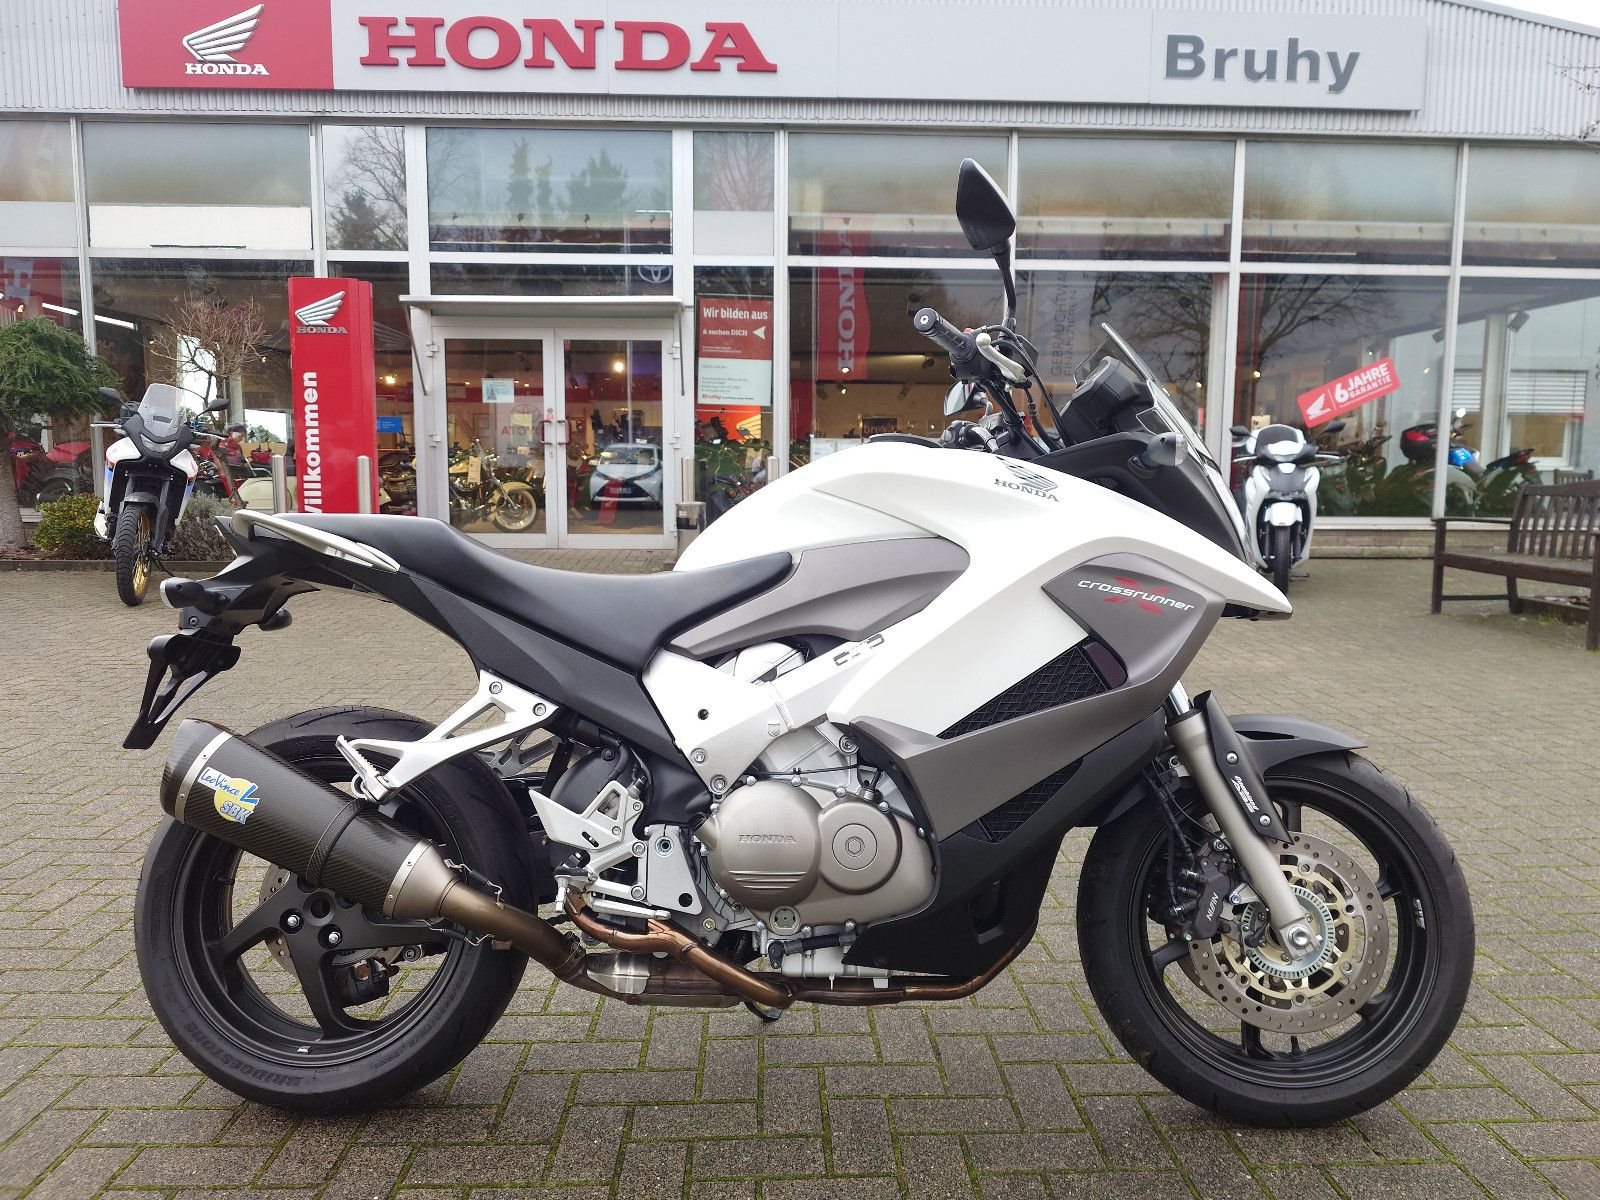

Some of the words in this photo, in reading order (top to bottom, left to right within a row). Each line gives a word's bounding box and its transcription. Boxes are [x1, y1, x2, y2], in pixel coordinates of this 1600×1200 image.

[358, 15, 778, 73] HONDA
[185, 61, 269, 76] HONDA
[1164, 34, 1361, 94] Bruhy
[703, 307, 719, 318] Wir
[721, 307, 749, 320] bilden
[751, 310, 768, 320] aus
[296, 326, 348, 334] HONDA
[708, 328, 730, 336] suchen
[1334, 383, 1349, 403] 6
[1347, 362, 1390, 391] JAHRE
[1350, 375, 1393, 399] GARANTIE
[994, 478, 1060, 502] HONDA
[1077, 580, 1194, 612] crossrunner
[201, 769, 240, 795] LeoVince
[220, 800, 250, 824] SBK
[738, 834, 797, 844] HONDA
